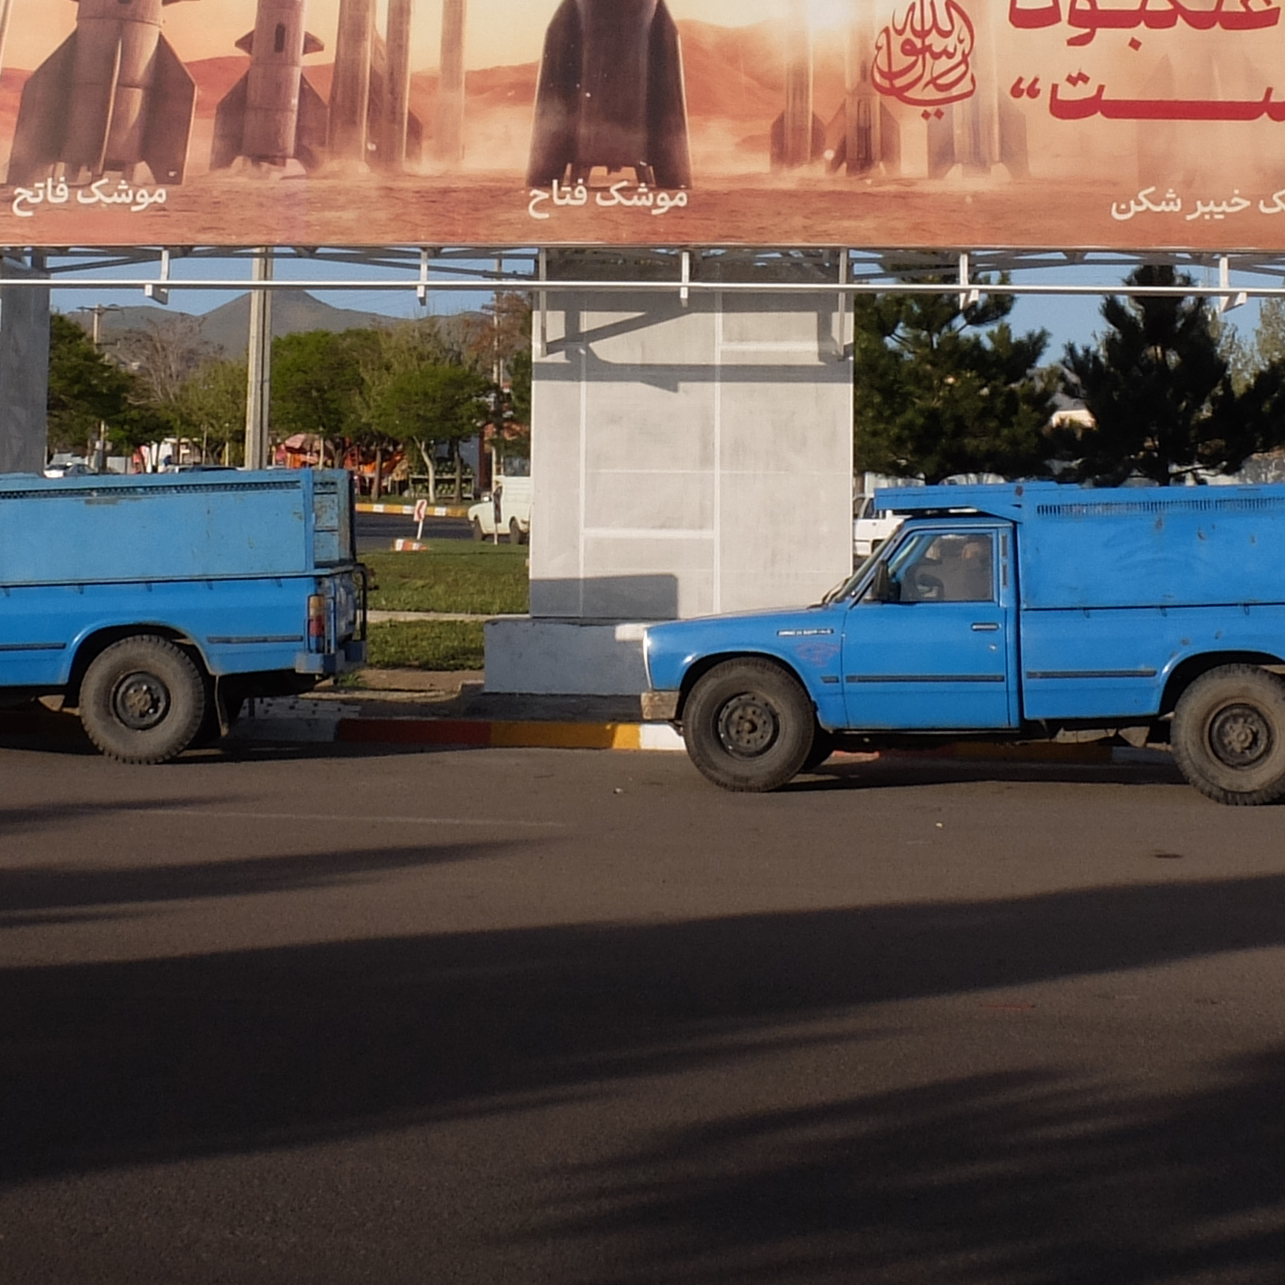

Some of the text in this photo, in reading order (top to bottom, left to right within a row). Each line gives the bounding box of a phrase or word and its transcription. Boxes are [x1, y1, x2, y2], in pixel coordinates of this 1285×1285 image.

[11, 175, 167, 218] موشک فاتح
[527, 177, 688, 220] موشک فتاح
